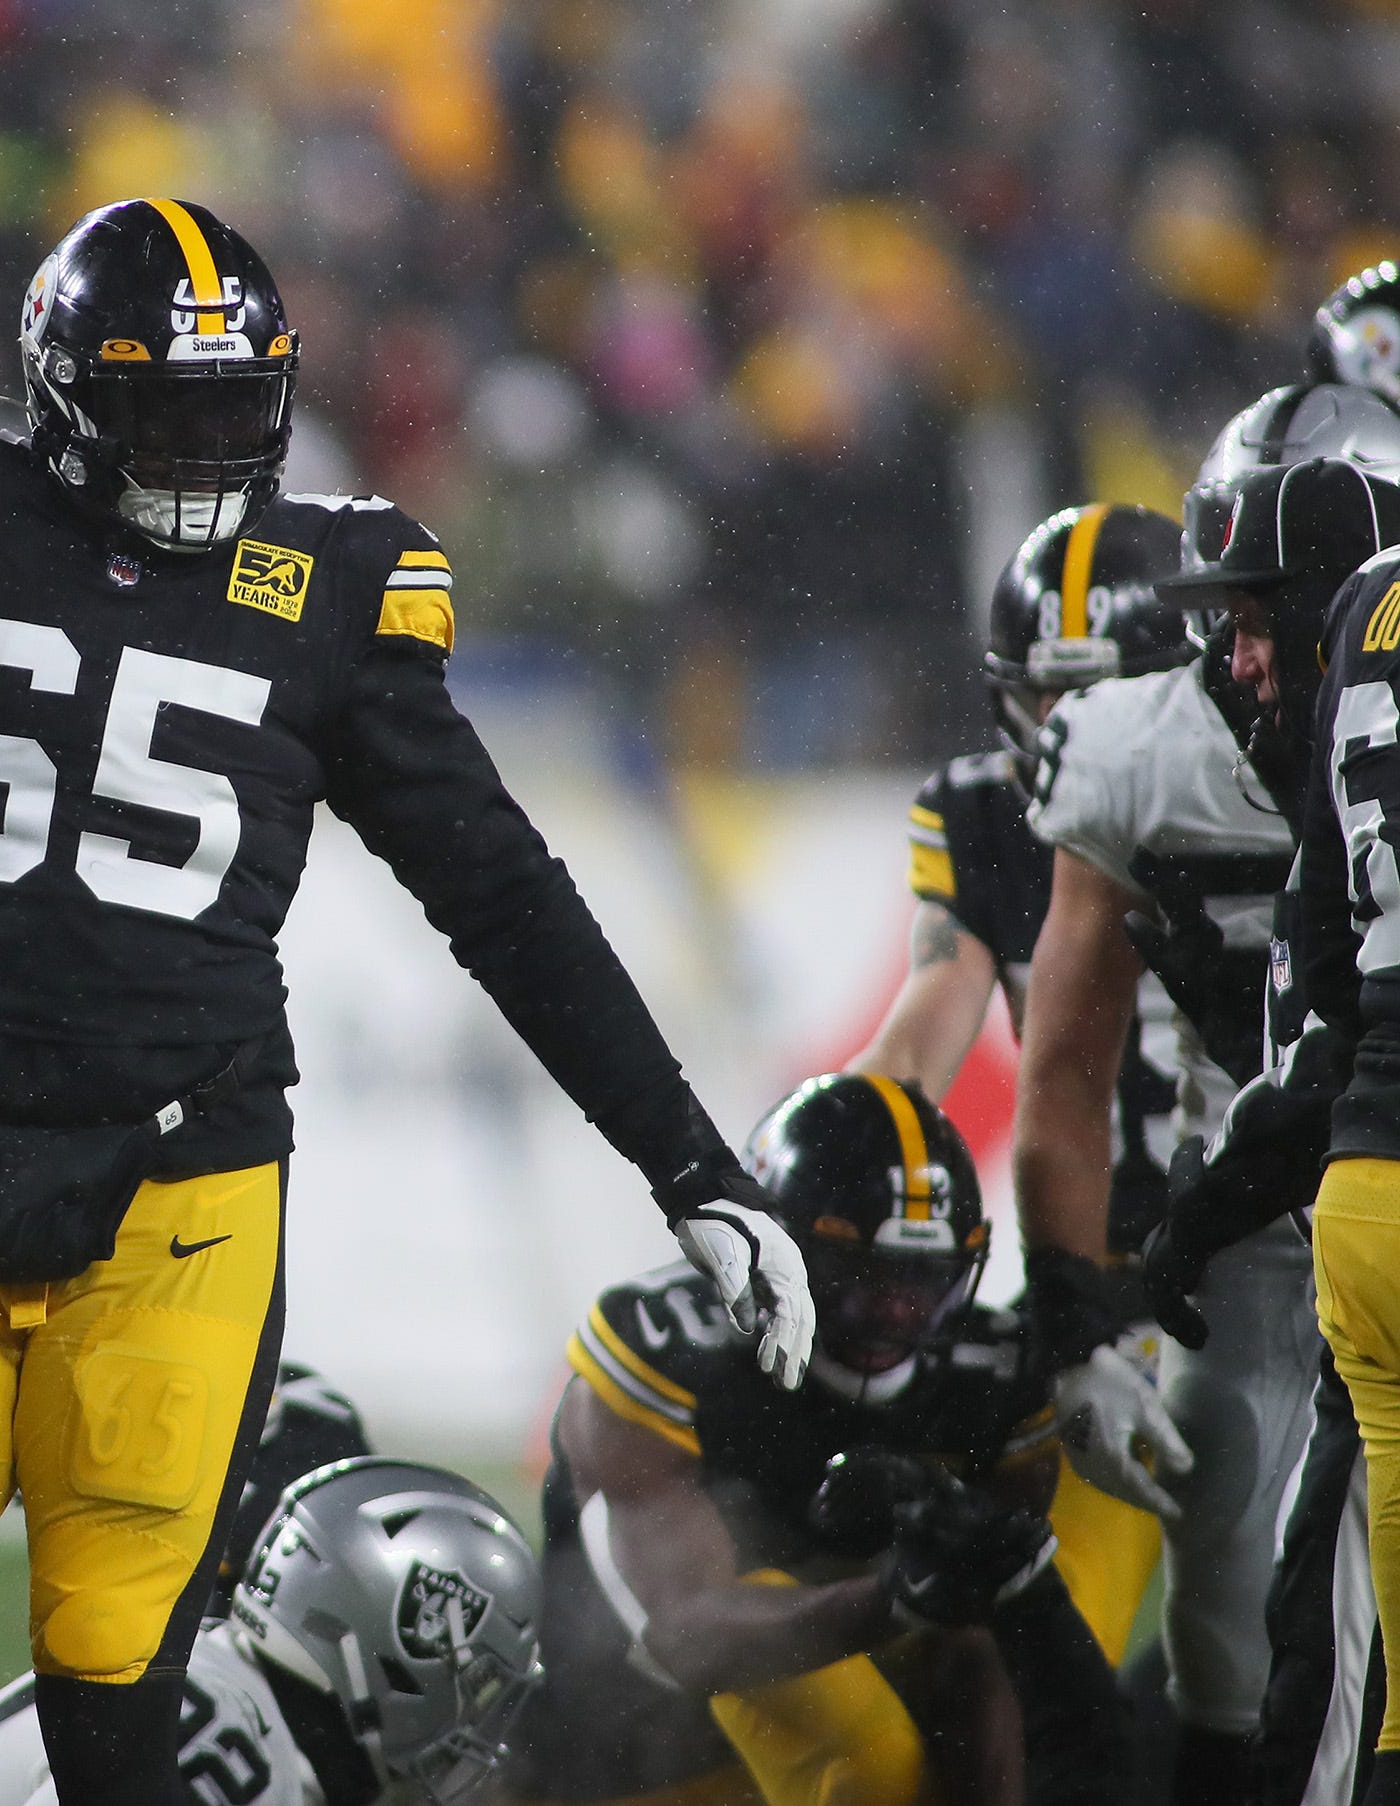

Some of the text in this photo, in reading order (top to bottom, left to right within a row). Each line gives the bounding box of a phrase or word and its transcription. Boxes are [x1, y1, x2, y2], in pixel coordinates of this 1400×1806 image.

[170, 276, 246, 333] 65
[192, 337, 236, 352] Steelers
[233, 584, 280, 610] YEARS
[1038, 586, 1111, 640] 89
[165, 1111, 178, 1125] 65
[887, 1164, 951, 1220] 13
[89, 1372, 194, 1476] 65
[417, 1565, 482, 1607] RAIDERS
